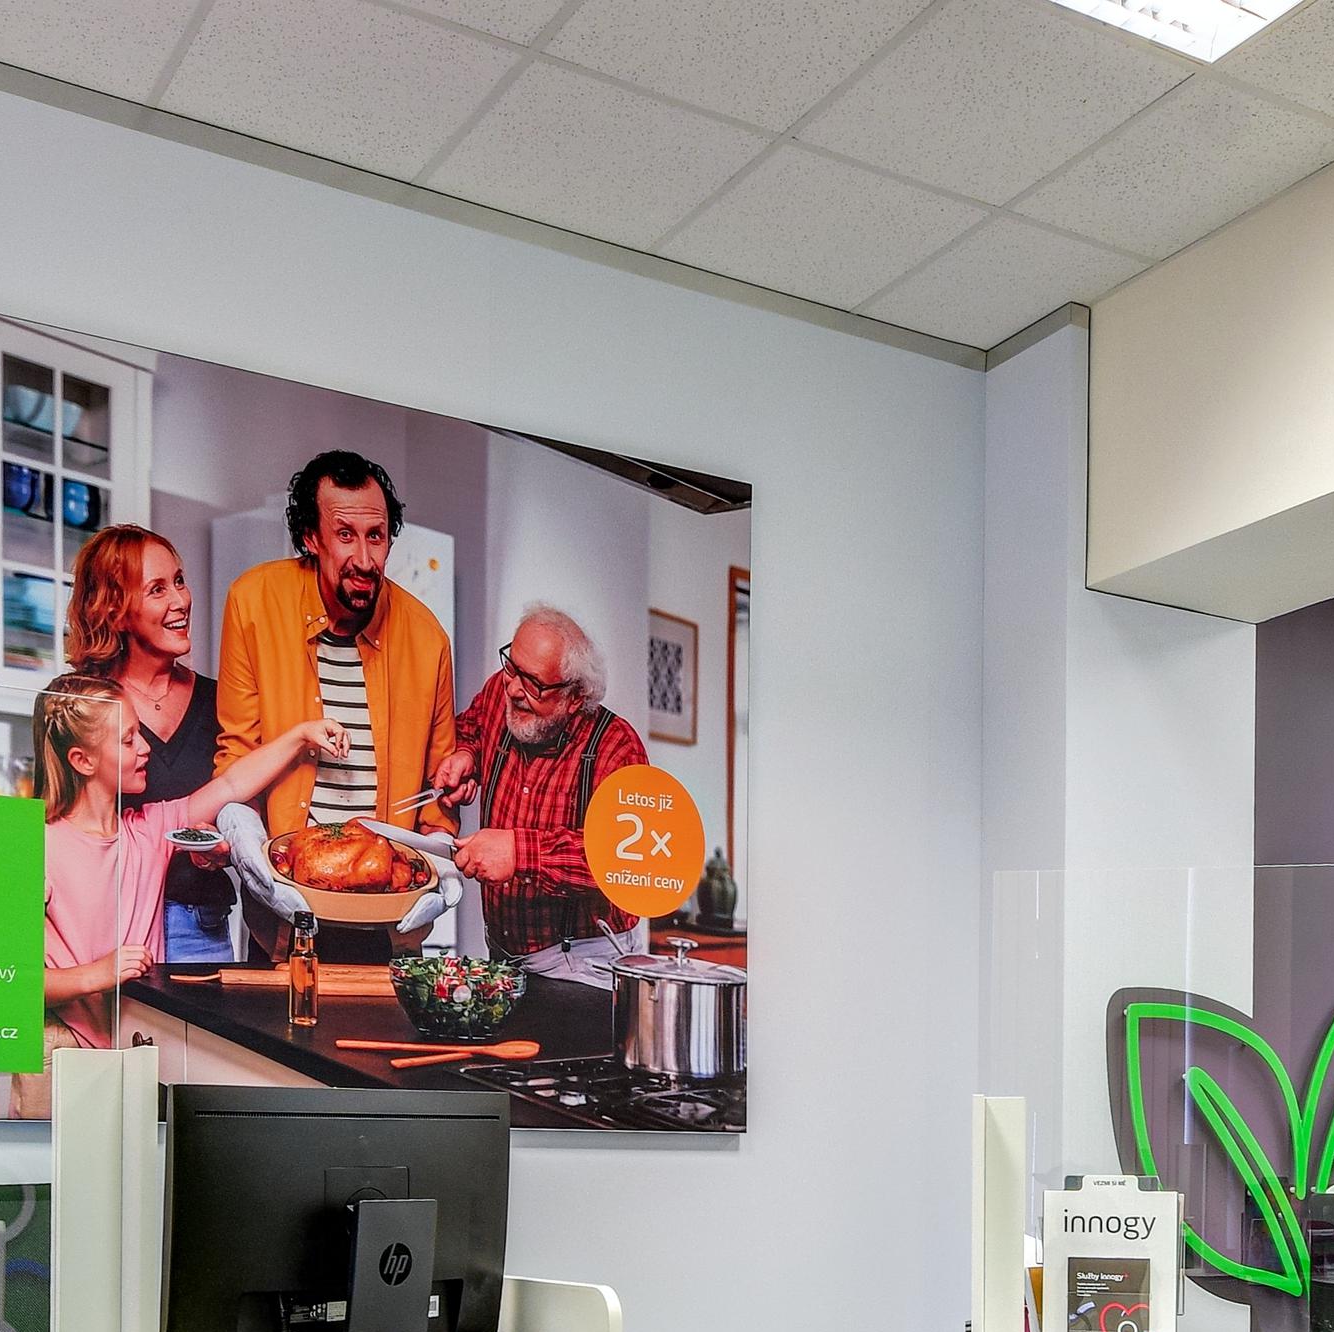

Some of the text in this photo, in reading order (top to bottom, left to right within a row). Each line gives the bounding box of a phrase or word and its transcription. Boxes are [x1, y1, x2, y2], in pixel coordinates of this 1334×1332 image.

[618, 789, 673, 812] Letos již
[605, 869, 684, 893] snížení ceny
[1064, 1209, 1156, 1240] innogy
[383, 1243, 409, 1287] hp
